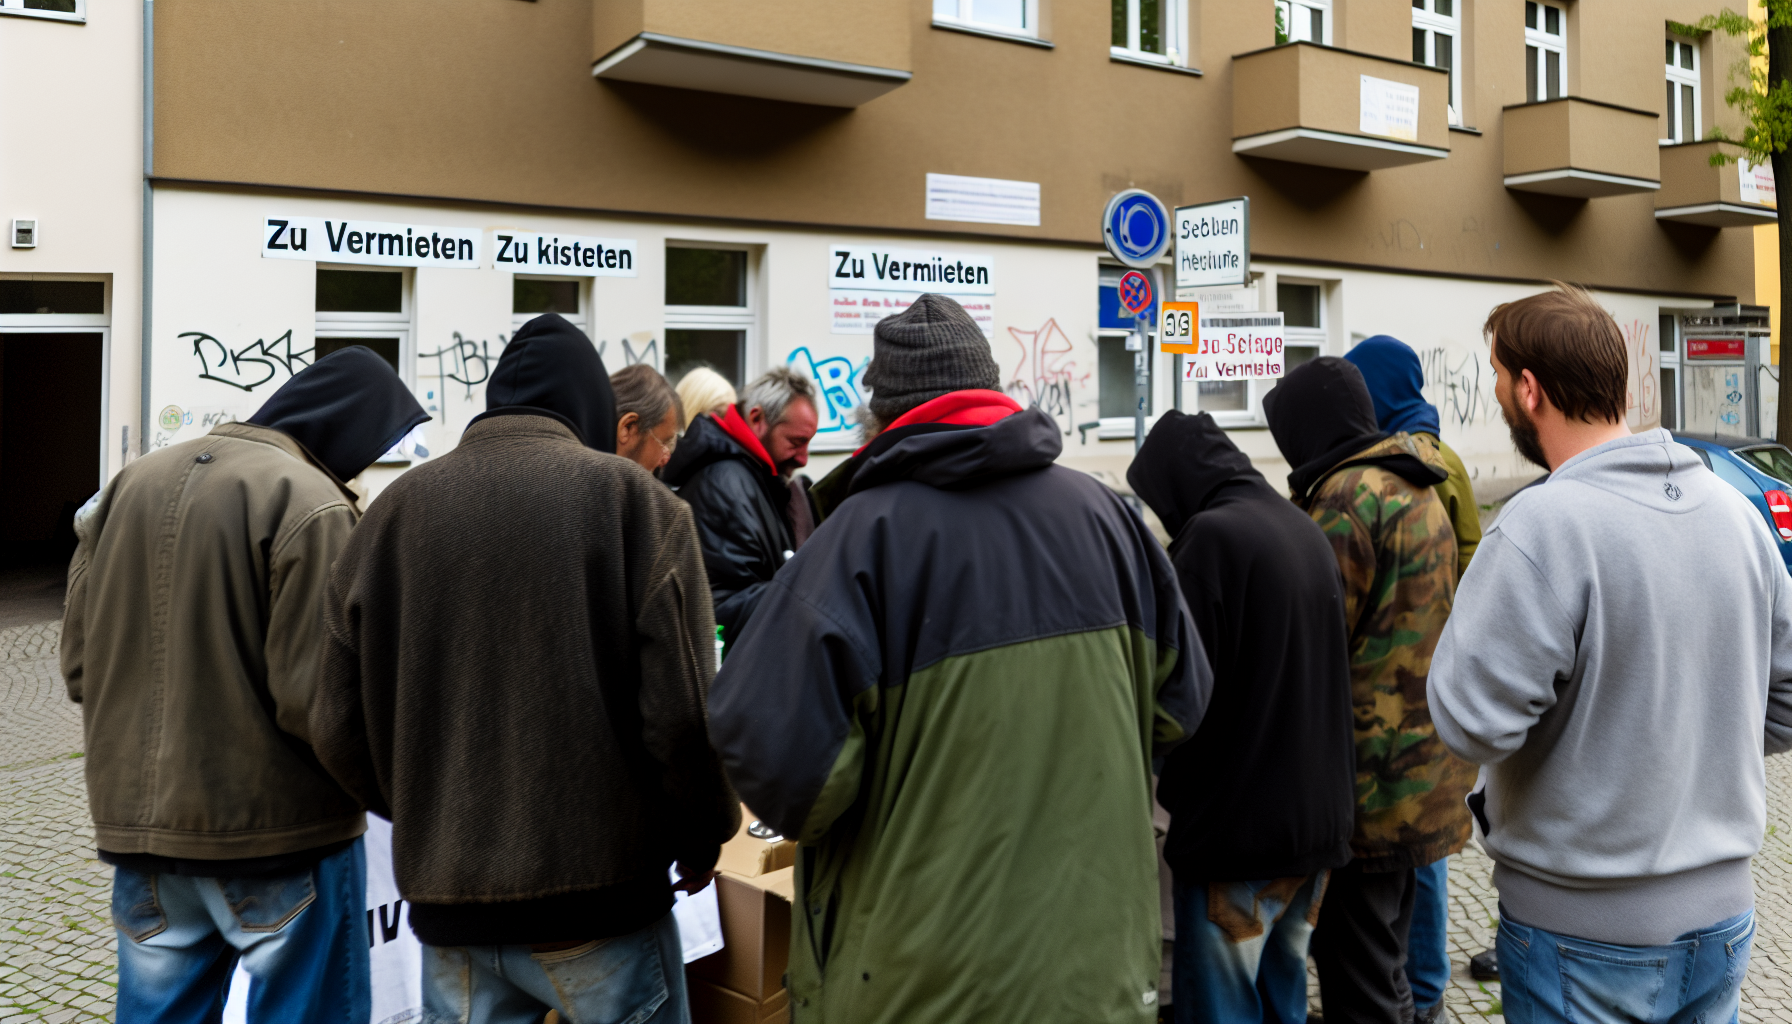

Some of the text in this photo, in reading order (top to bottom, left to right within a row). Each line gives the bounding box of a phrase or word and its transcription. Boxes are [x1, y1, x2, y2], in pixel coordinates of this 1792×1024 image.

[267, 219, 474, 262] Zu Vermieten
[496, 234, 632, 270] Zu kisteten
[835, 251, 865, 279] Zu
